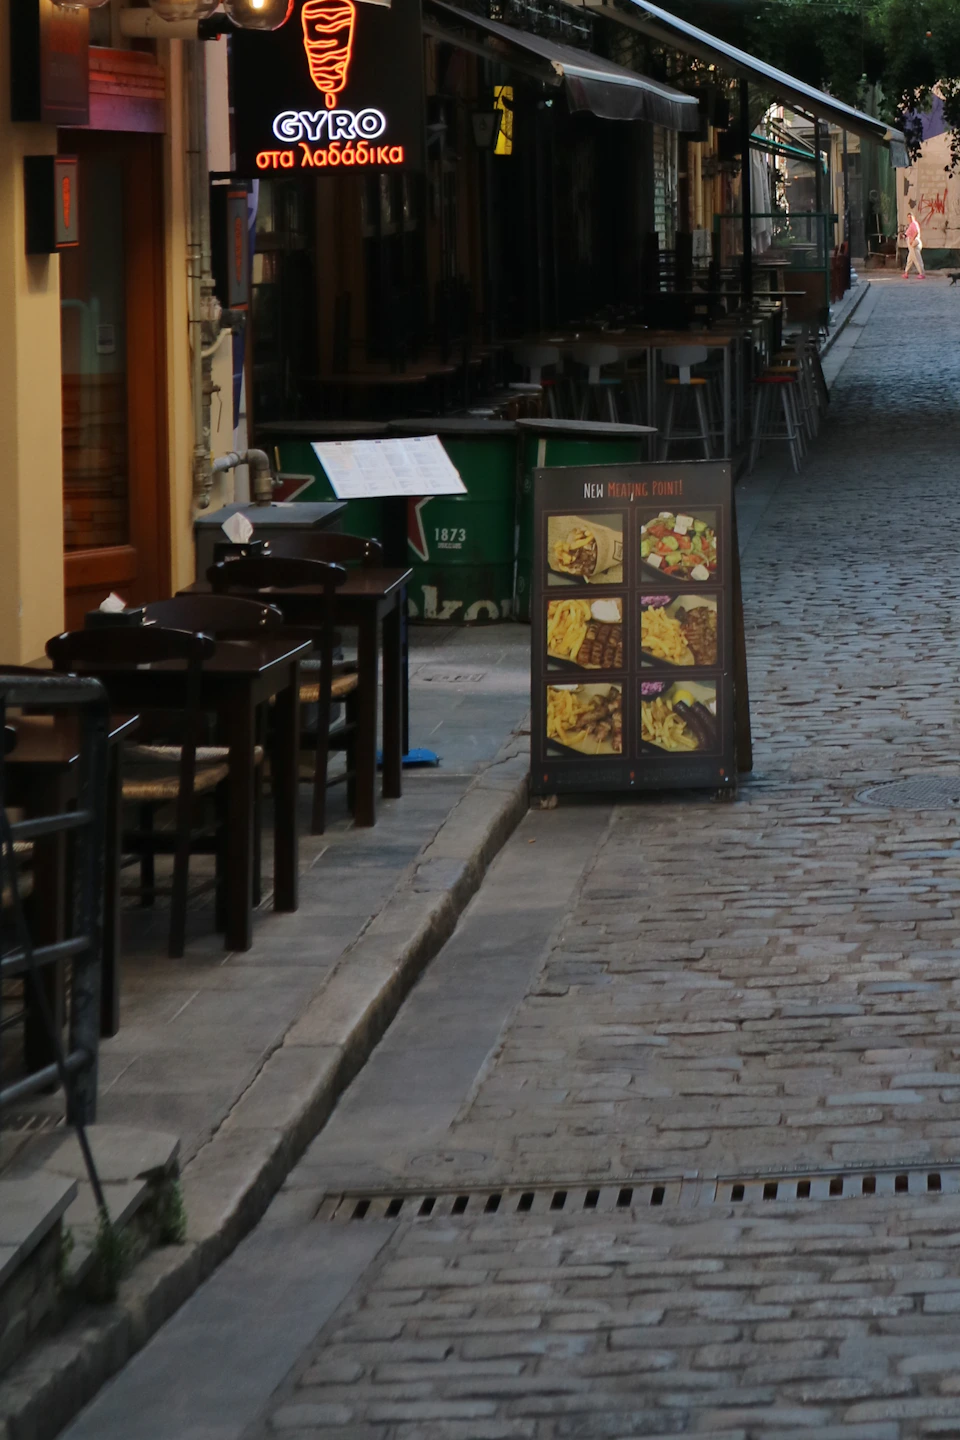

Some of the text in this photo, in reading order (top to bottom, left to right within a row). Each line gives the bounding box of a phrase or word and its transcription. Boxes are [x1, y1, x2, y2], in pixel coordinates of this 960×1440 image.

[272, 108, 386, 143] GYRO
[255, 141, 404, 170] στα λαδάδικα
[434, 527, 467, 542] 1873
